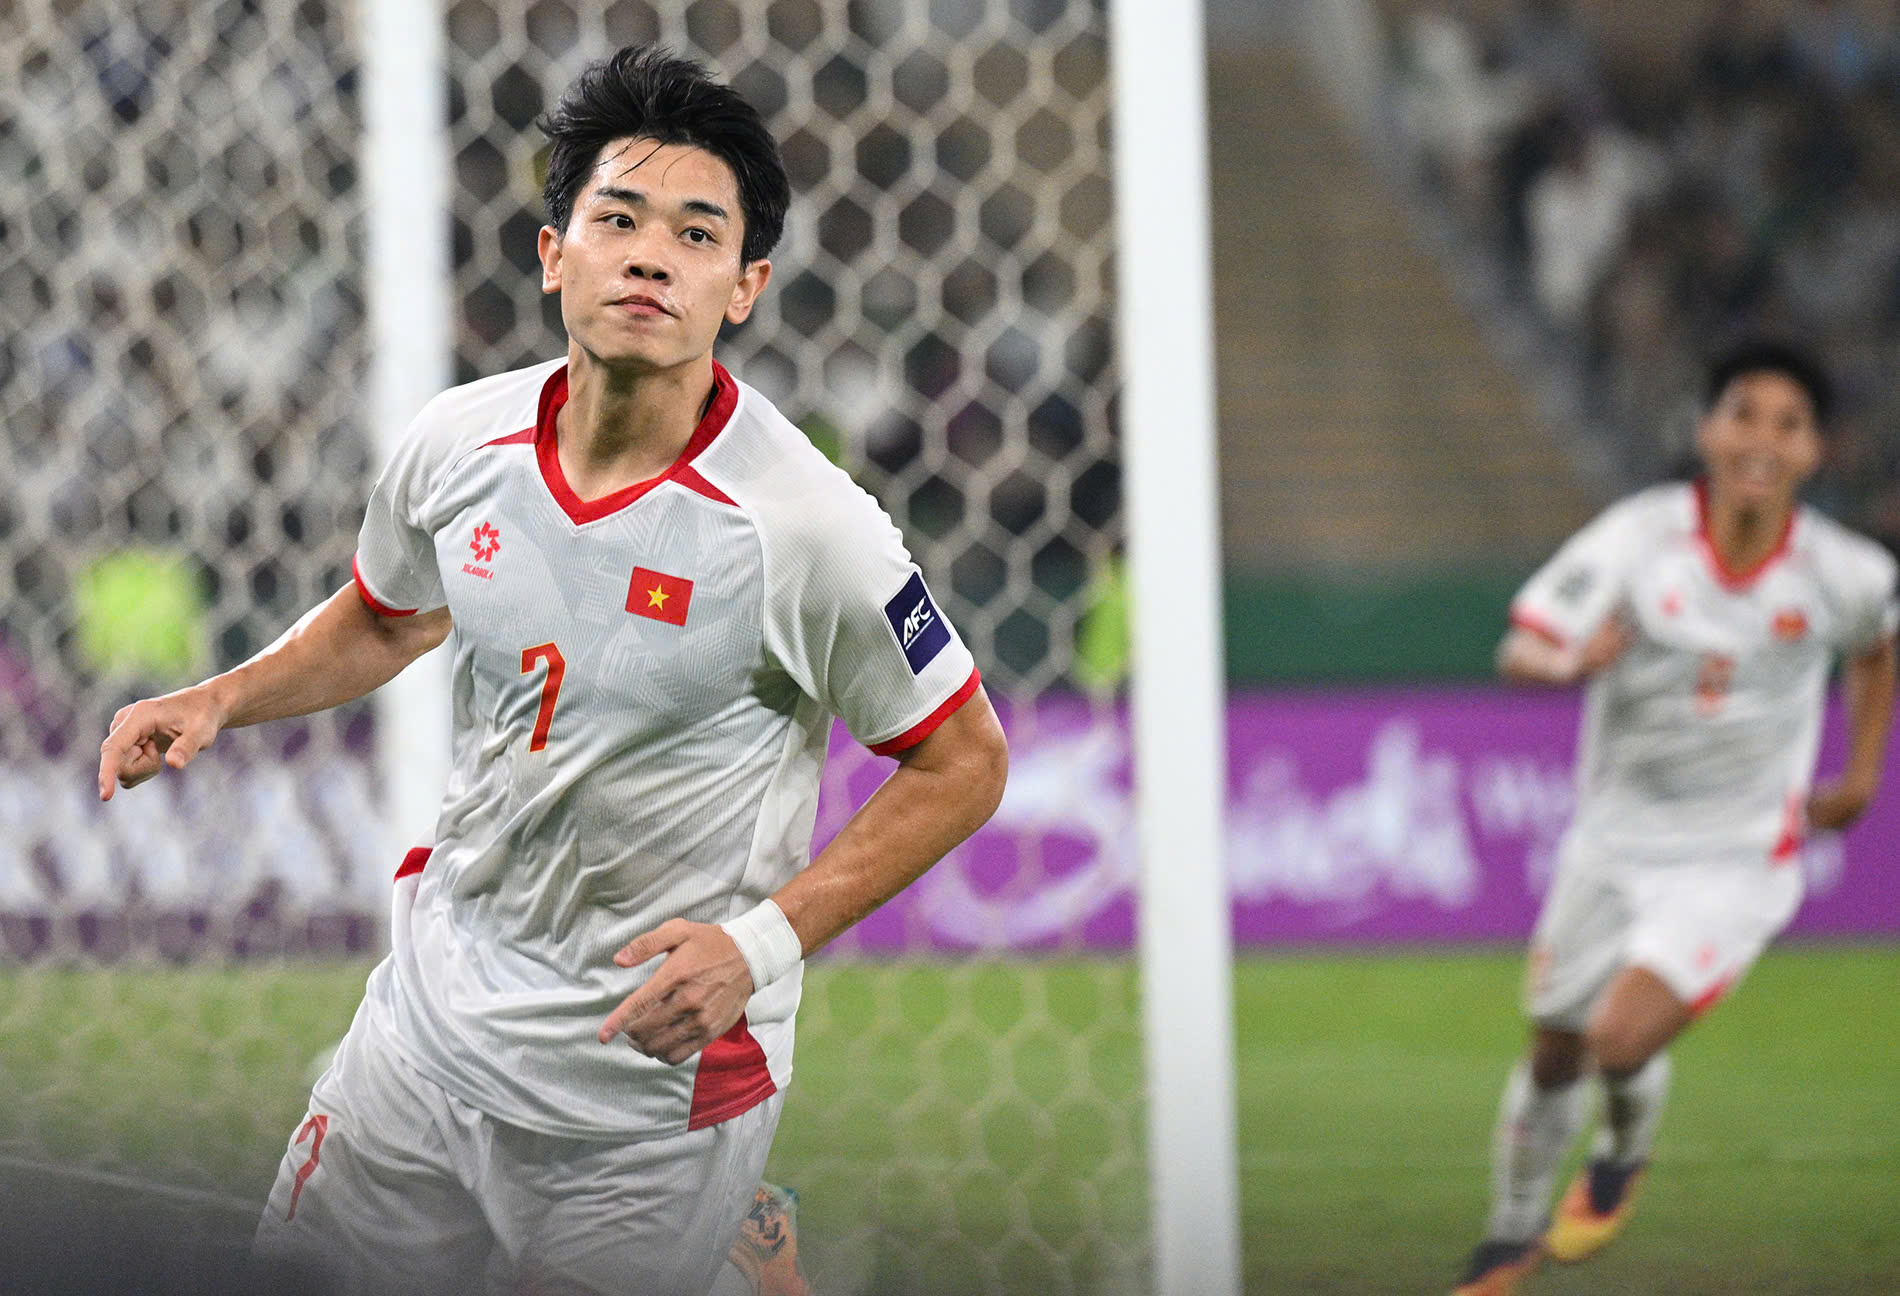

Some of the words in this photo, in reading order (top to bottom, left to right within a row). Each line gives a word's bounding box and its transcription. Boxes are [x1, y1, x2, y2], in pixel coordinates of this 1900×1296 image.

[903, 596, 931, 645] AFC
[520, 642, 566, 752] 7
[287, 1114, 328, 1221] 7
